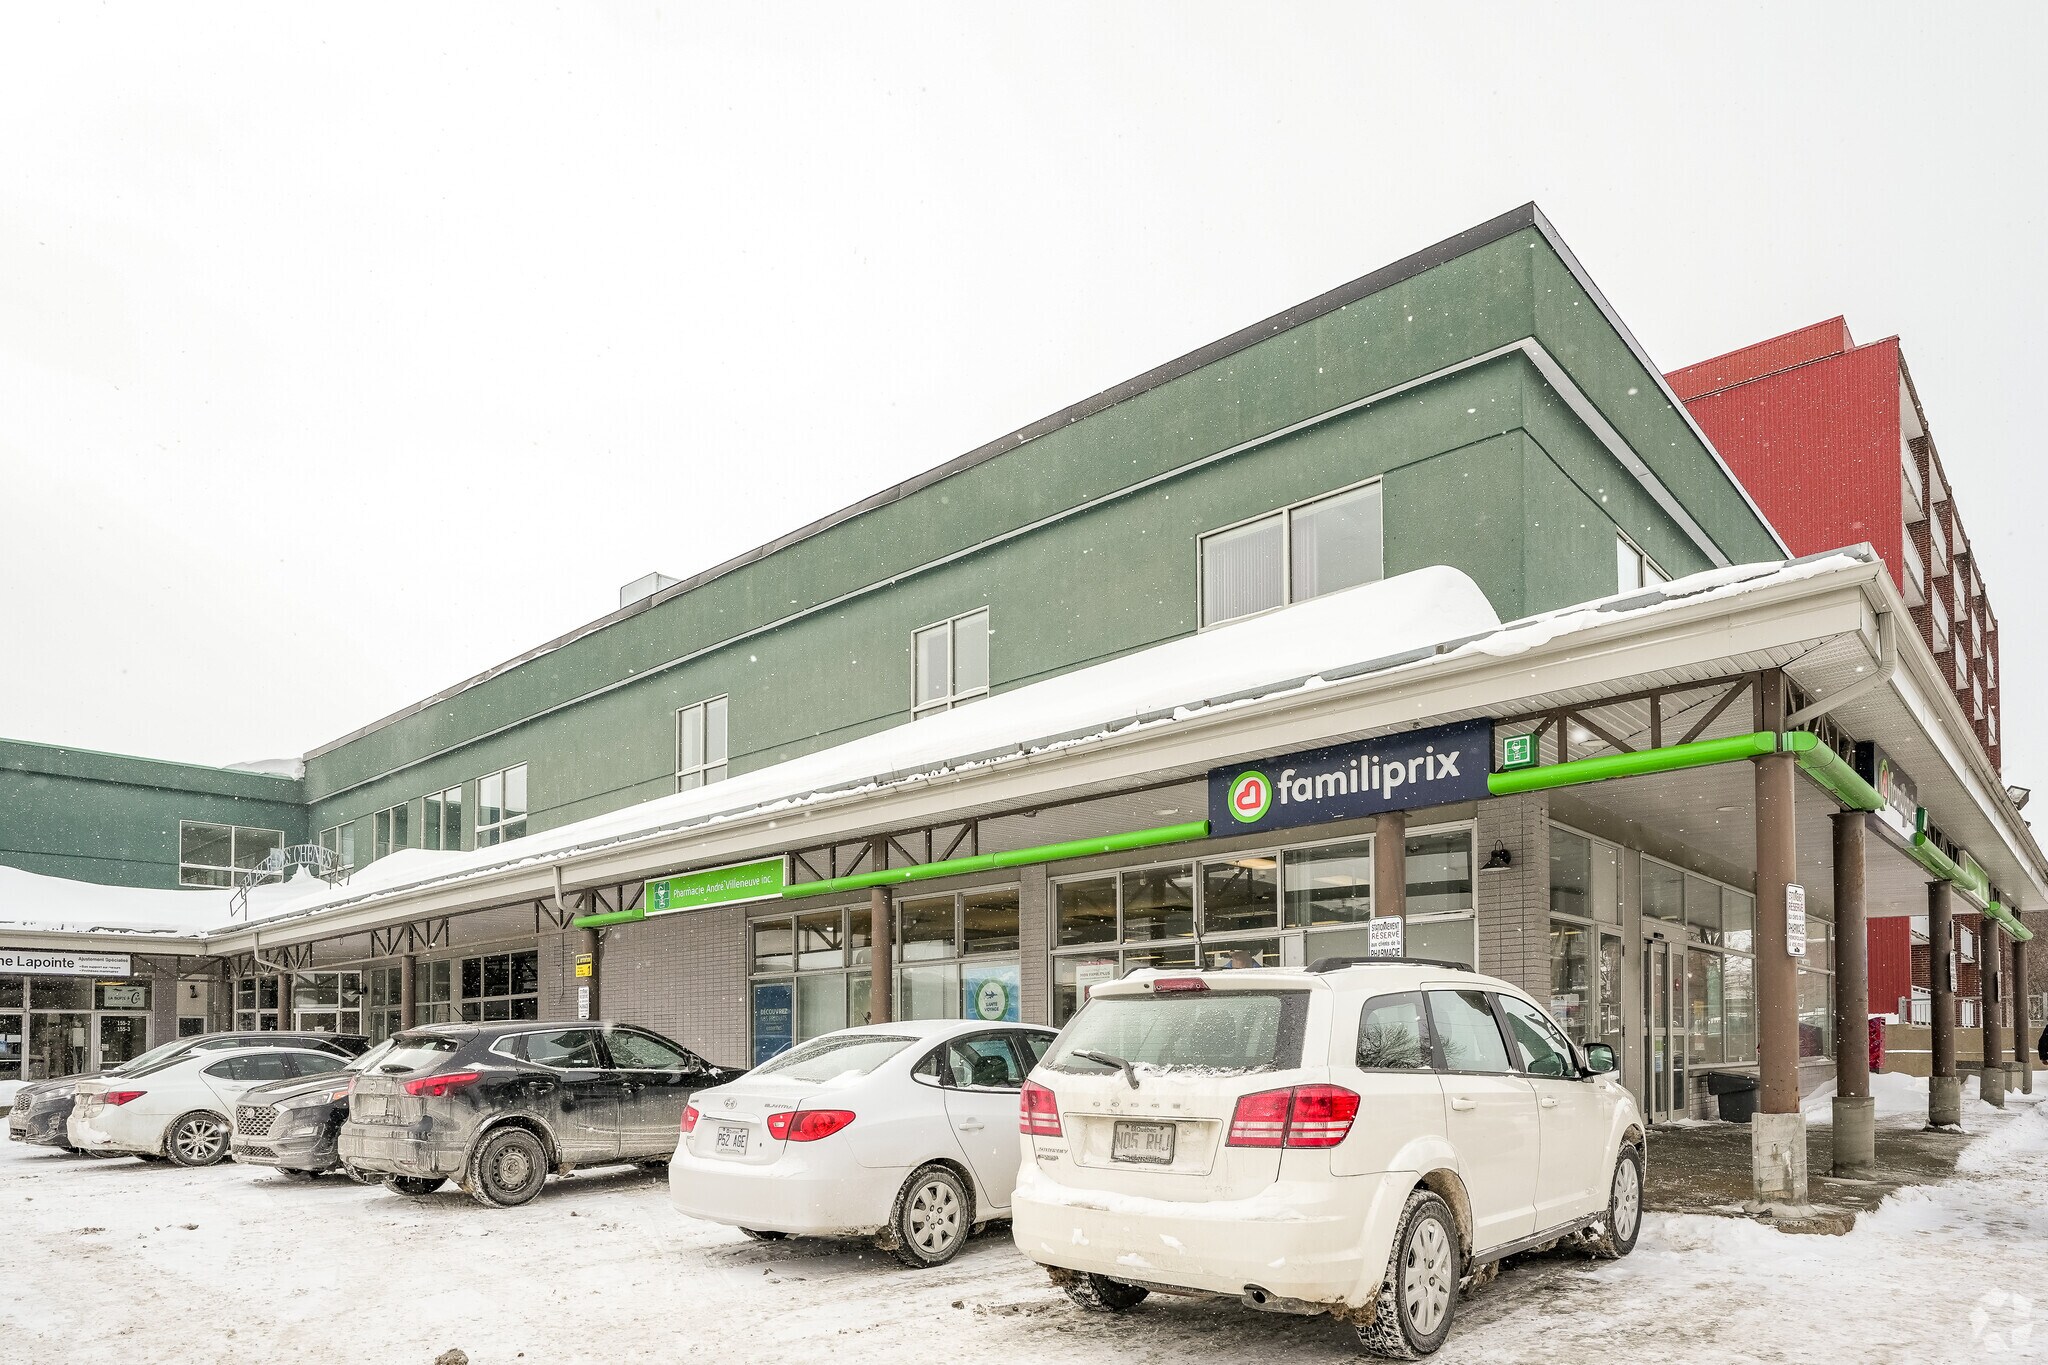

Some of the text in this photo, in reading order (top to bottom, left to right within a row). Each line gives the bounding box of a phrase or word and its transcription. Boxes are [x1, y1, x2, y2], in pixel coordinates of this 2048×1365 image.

[1277, 746, 1461, 805] familiprix
[674, 886, 704, 898] Pharmacie
[725, 878, 759, 890] Villeneuve
[17, 956, 75, 969] Lapointe
[717, 1133, 730, 1147] P52
